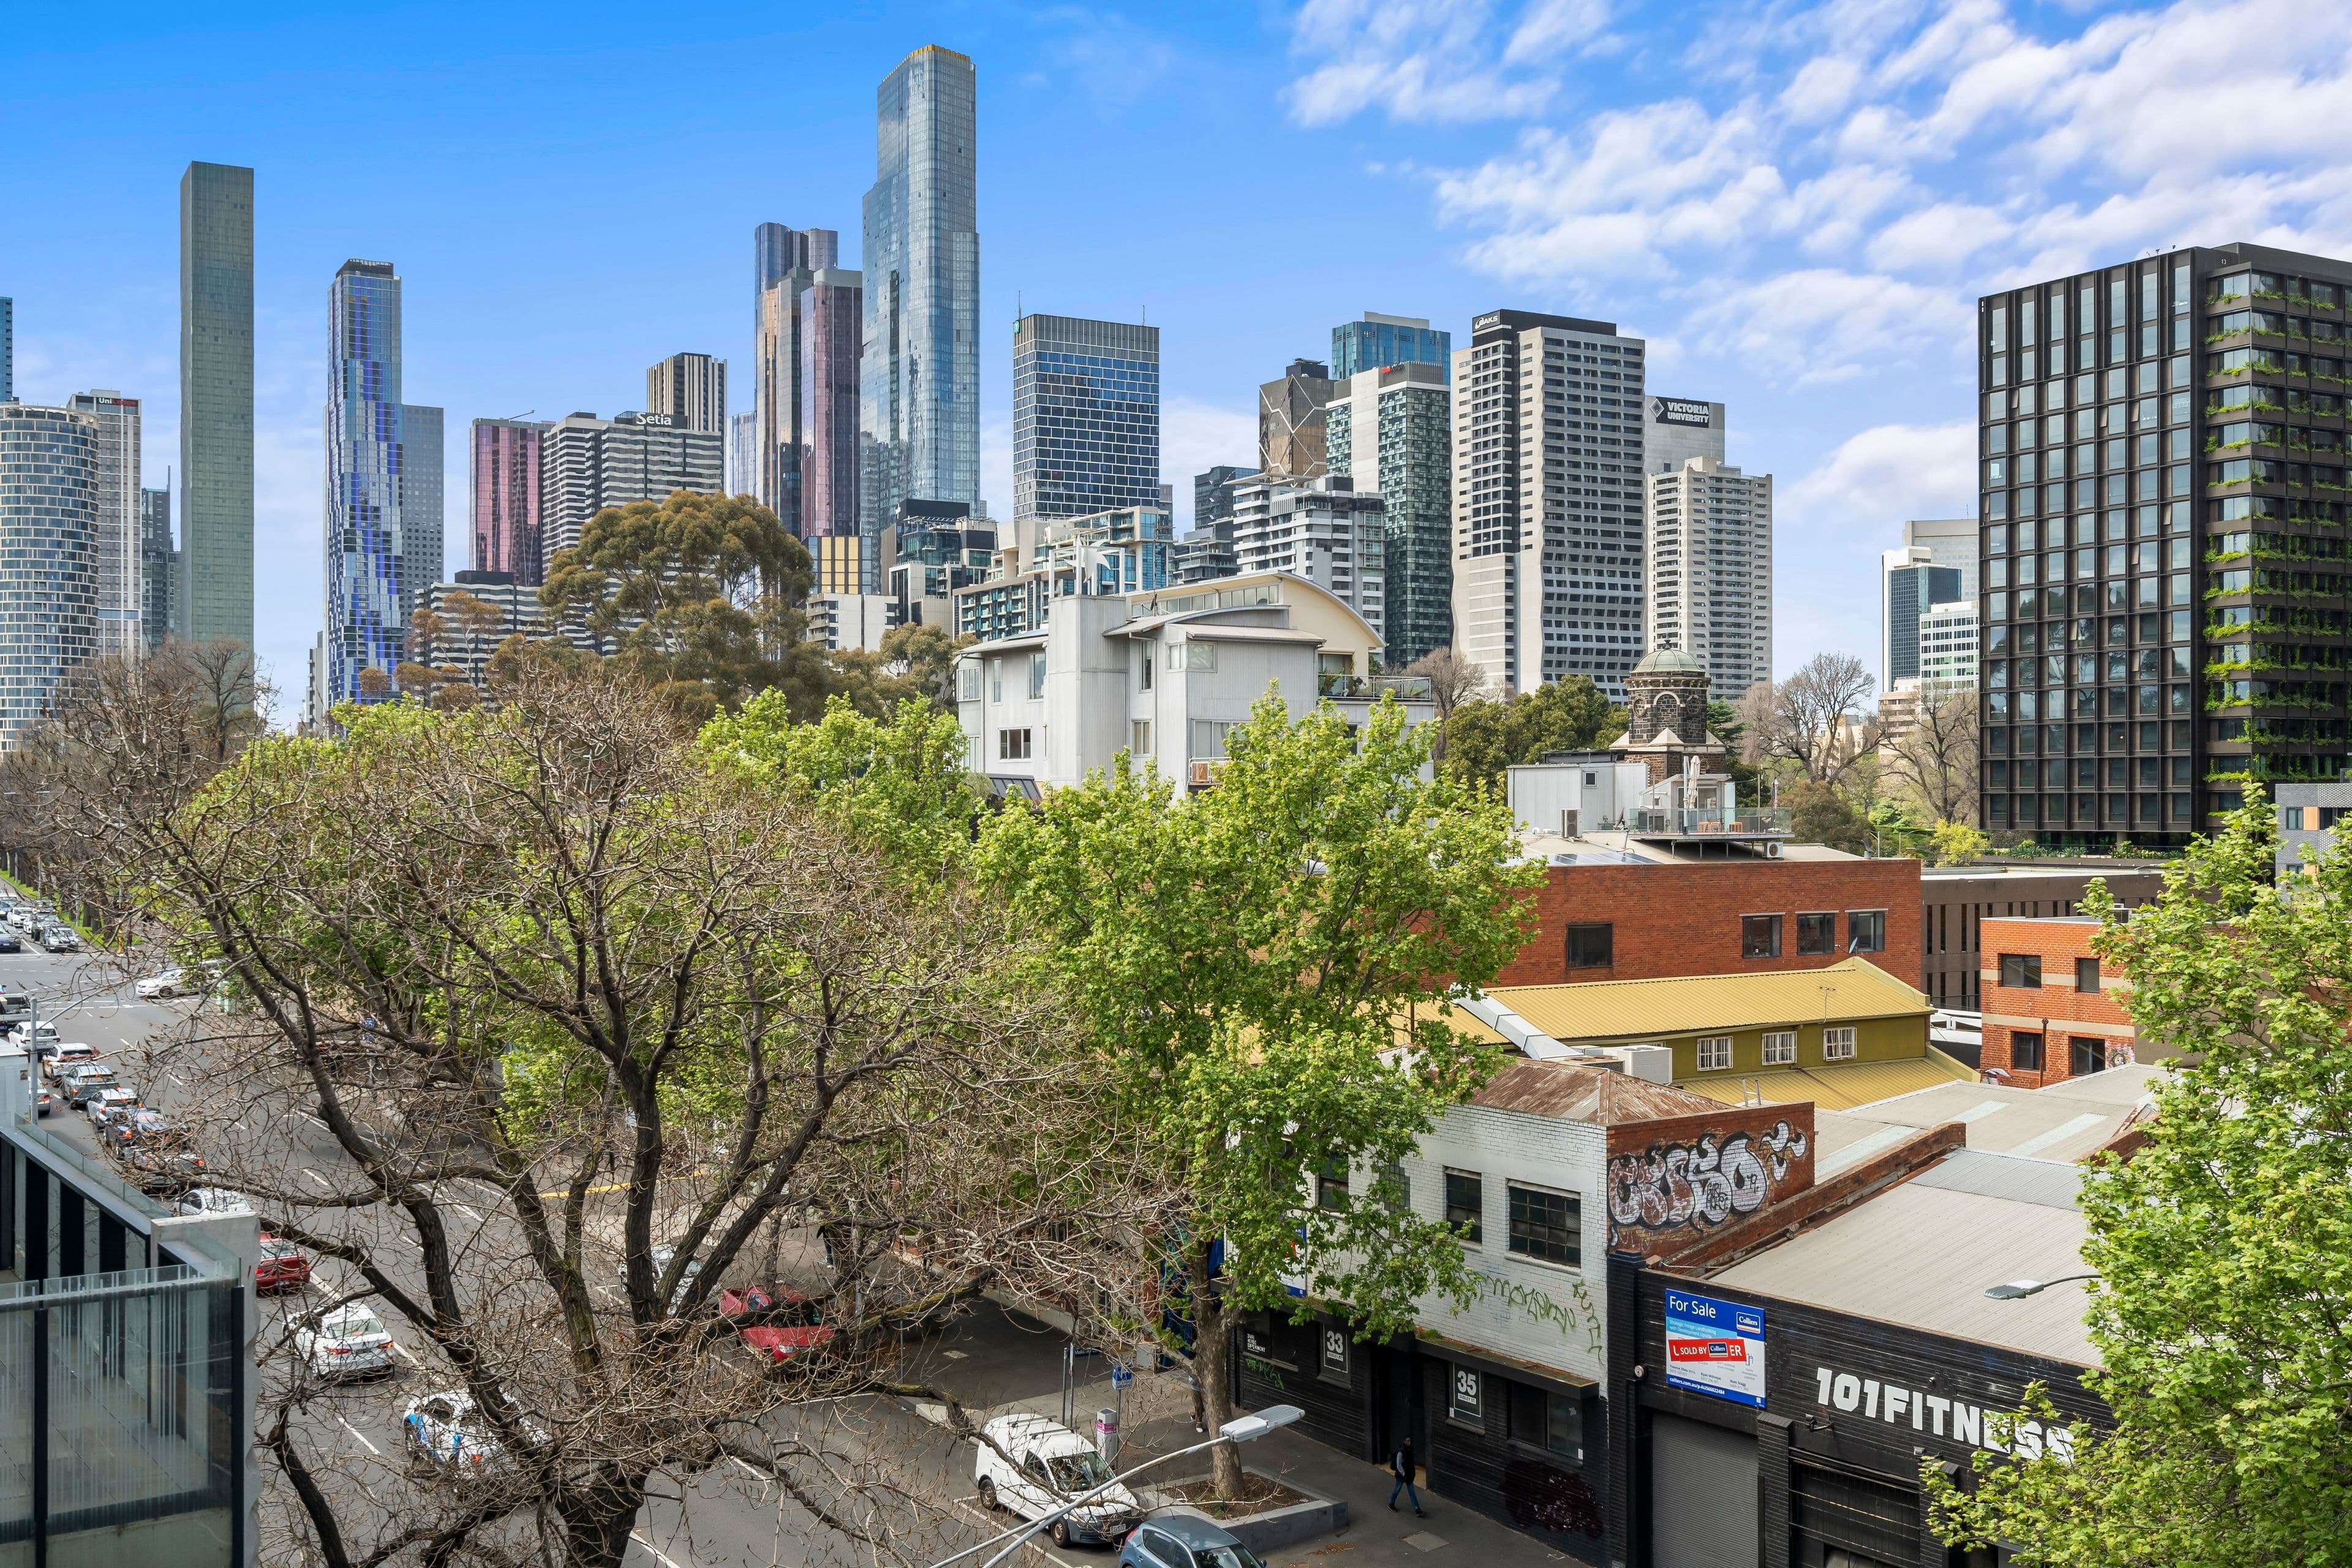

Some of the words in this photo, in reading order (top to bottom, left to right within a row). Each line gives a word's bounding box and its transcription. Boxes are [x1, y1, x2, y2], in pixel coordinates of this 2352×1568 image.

[1667, 402, 1709, 415] VICTORIA
[636, 412, 672, 426] Setia
[1667, 412, 1709, 423] UNIVERSITY
[1670, 1295, 1689, 1312] For
[1691, 1300, 1716, 1318] Sale
[1738, 1316, 1758, 1326] Colliers
[1327, 1330, 1343, 1354] 33
[1680, 1346, 1697, 1355] SOLD
[1698, 1346, 1707, 1355] BY
[1458, 1371, 1477, 1396] 35
